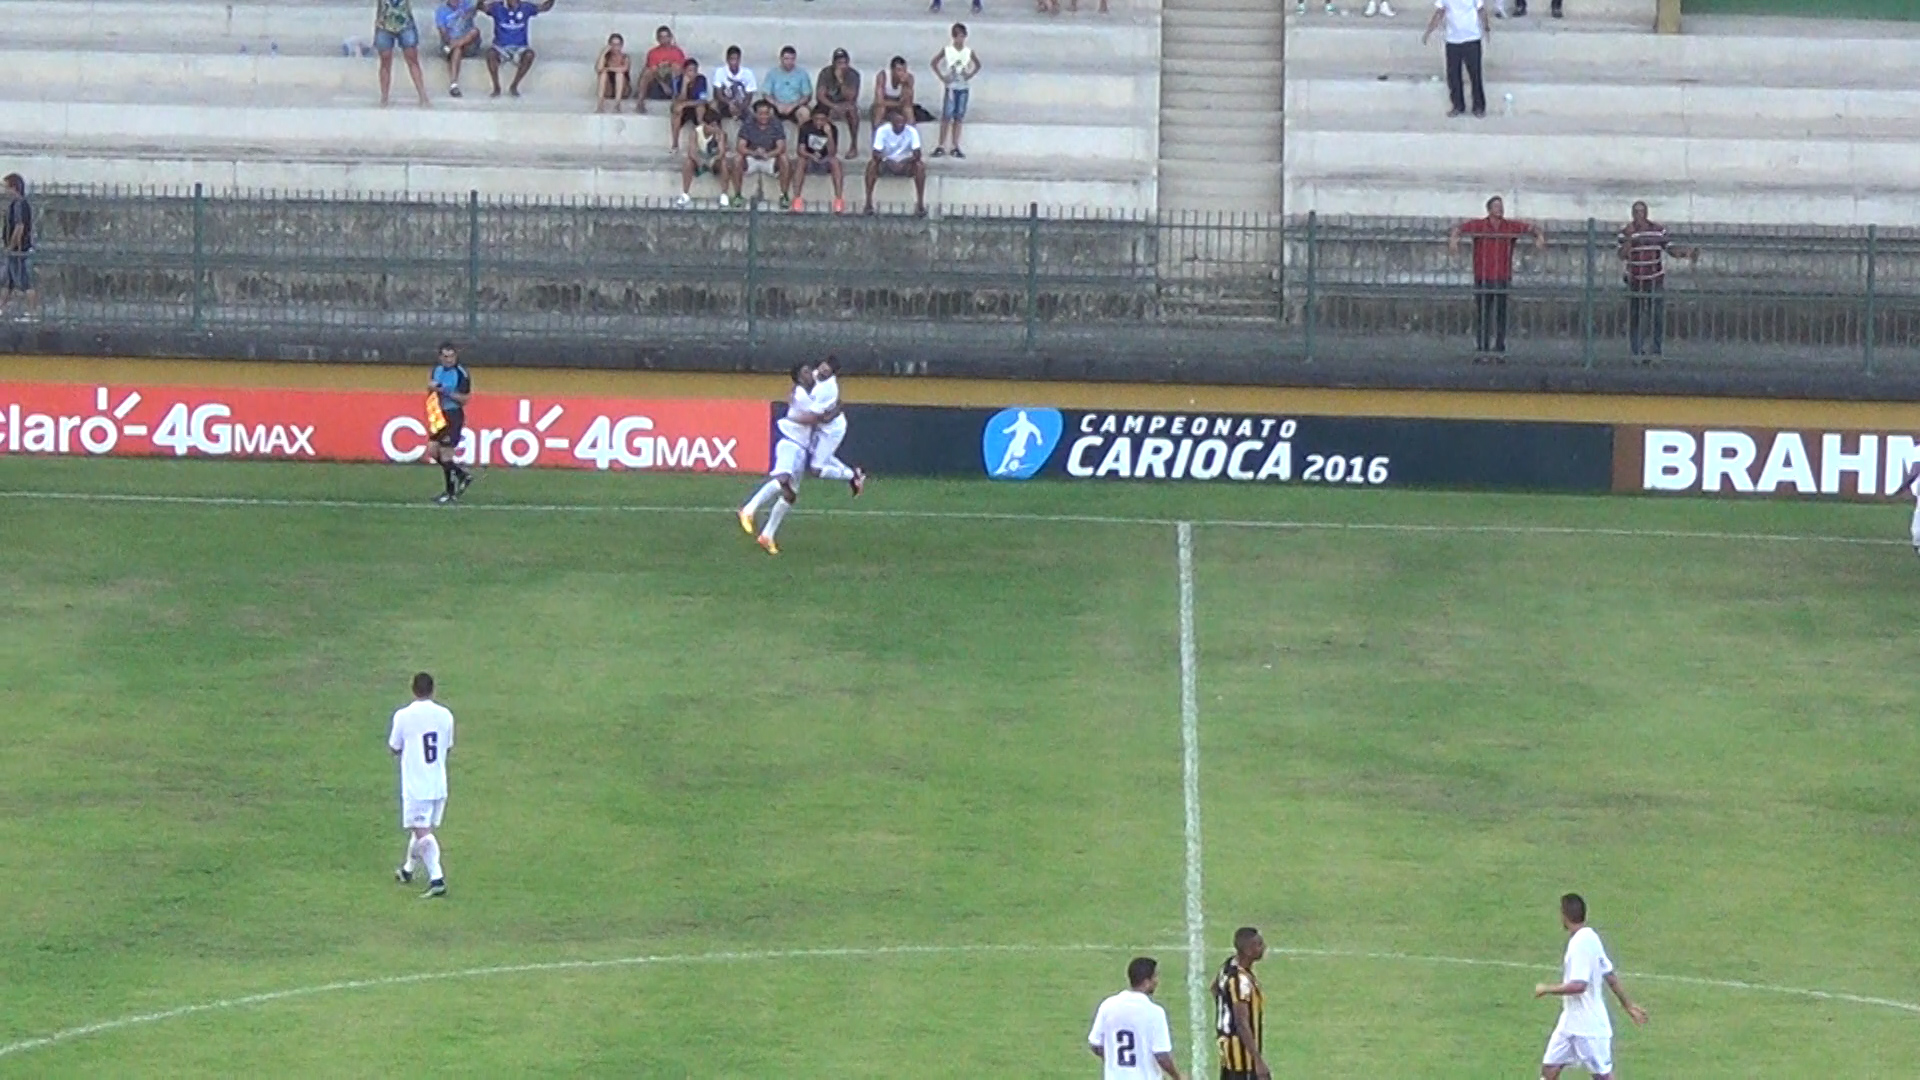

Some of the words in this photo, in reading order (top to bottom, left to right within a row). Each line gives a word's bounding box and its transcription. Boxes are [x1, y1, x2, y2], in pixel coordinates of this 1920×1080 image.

[0, 403, 118, 454] laro
[381, 415, 540, 467] Caro
[1080, 412, 1298, 439] CAMPEONATO
[1065, 435, 1293, 481] CARIOCA
[1301, 454, 1390, 484] 2016
[422, 731, 438, 765] 6
[1116, 1029, 1137, 1068] 2
